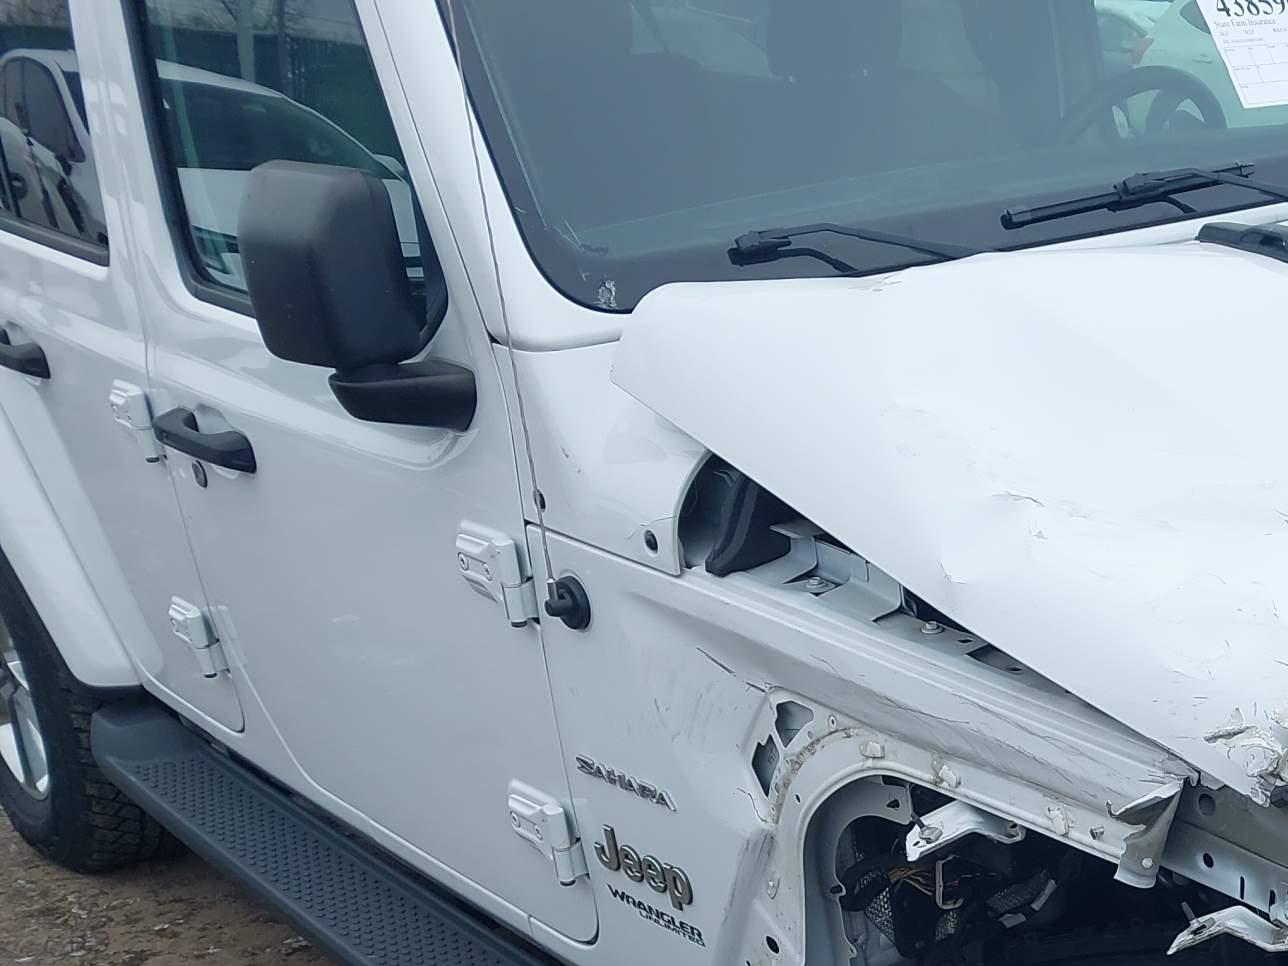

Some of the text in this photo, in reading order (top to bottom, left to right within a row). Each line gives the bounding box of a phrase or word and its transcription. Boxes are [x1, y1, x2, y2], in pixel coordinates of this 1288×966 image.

[576, 753, 677, 812] SAHARA
[594, 824, 694, 911] Jeep
[607, 883, 704, 941] WRANGLER
[639, 910, 706, 947] UNLIMITED
